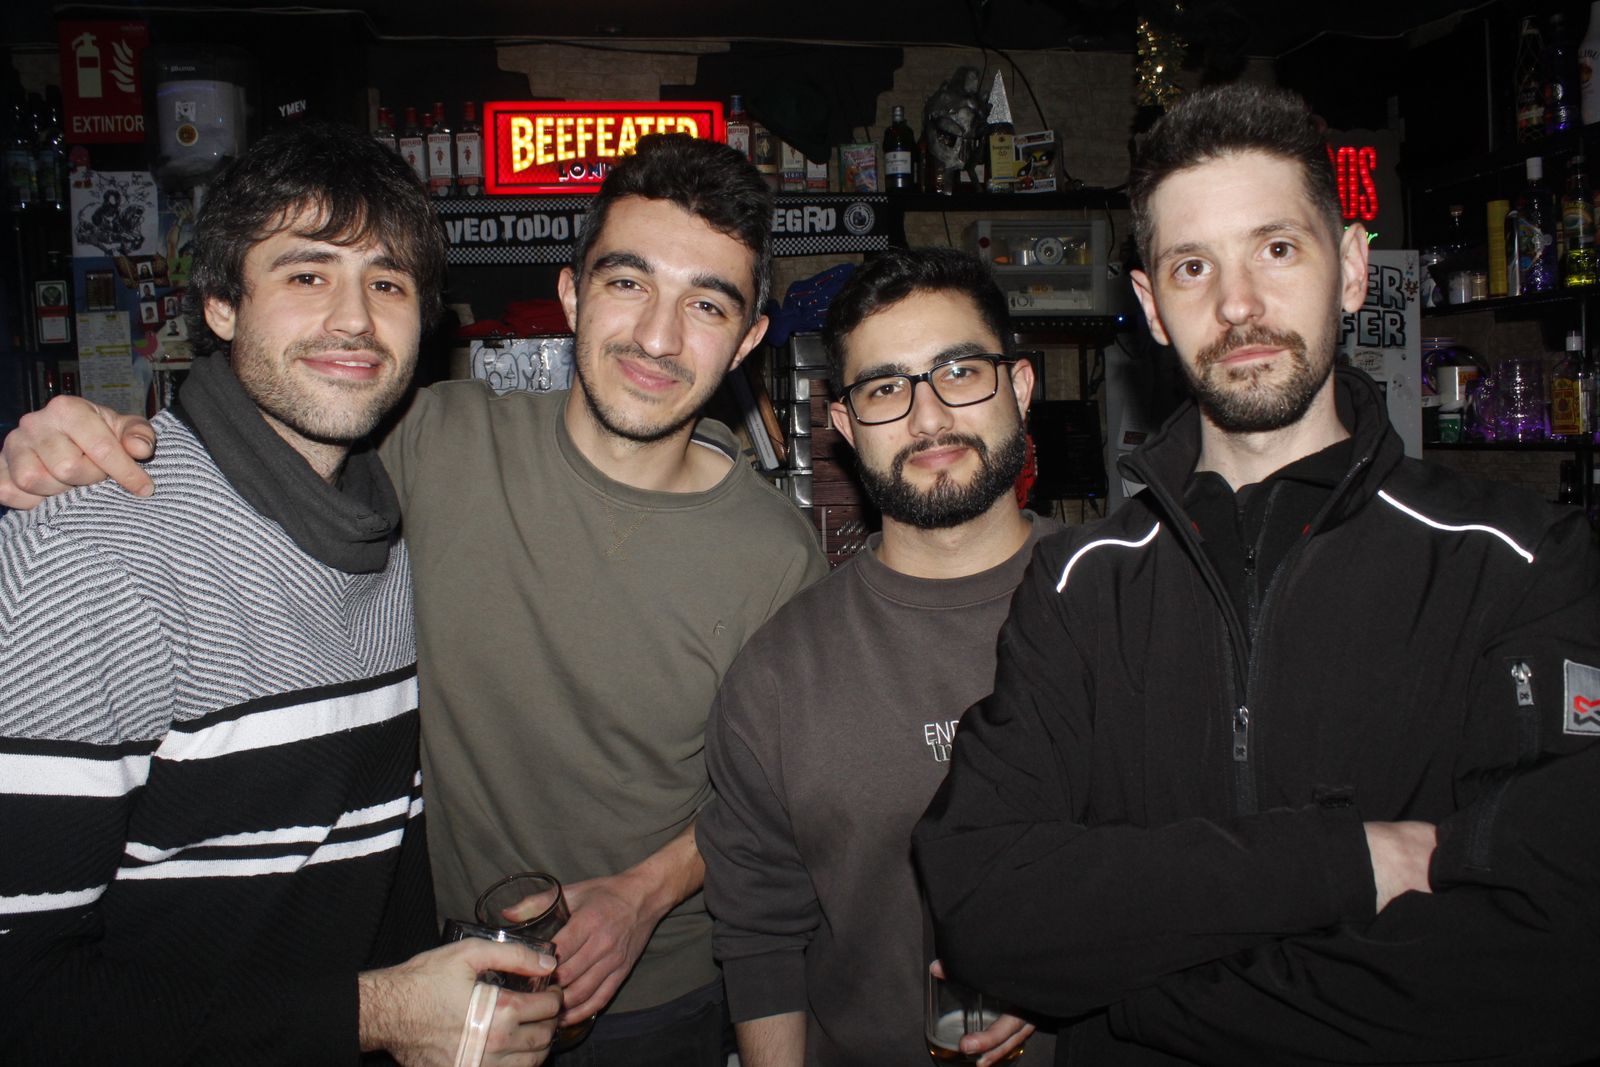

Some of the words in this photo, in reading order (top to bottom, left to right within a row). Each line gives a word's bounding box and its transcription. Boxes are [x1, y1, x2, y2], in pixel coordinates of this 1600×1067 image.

[72, 114, 145, 134] EXTINTOR
[1326, 144, 1378, 221] OS
[445, 217, 498, 244] VEO
[771, 205, 836, 234] EGRO
[1365, 264, 1406, 310] ER
[1338, 308, 1406, 348] FER
